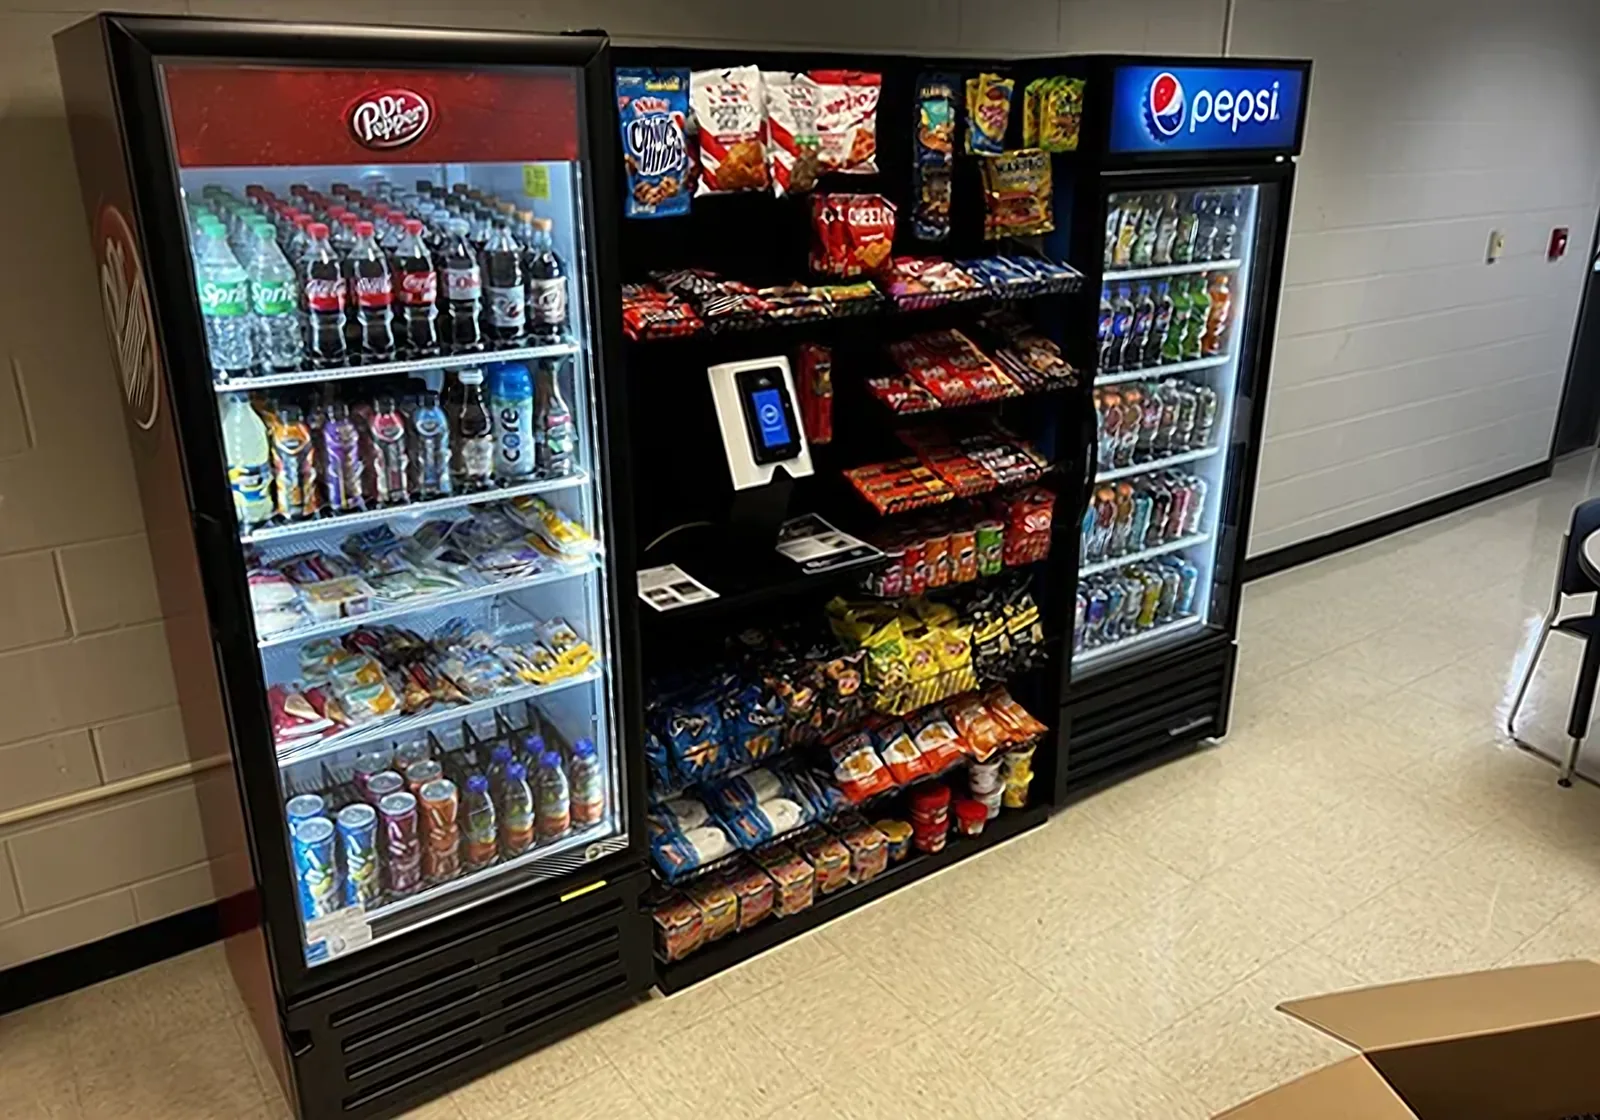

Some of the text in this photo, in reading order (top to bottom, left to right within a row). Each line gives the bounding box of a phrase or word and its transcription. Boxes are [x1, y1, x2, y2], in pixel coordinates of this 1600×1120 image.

[353, 101, 423, 141] Pepper
[379, 95, 406, 119] Dr
[1189, 80, 1280, 133] pepsi
[500, 407, 521, 463] core
